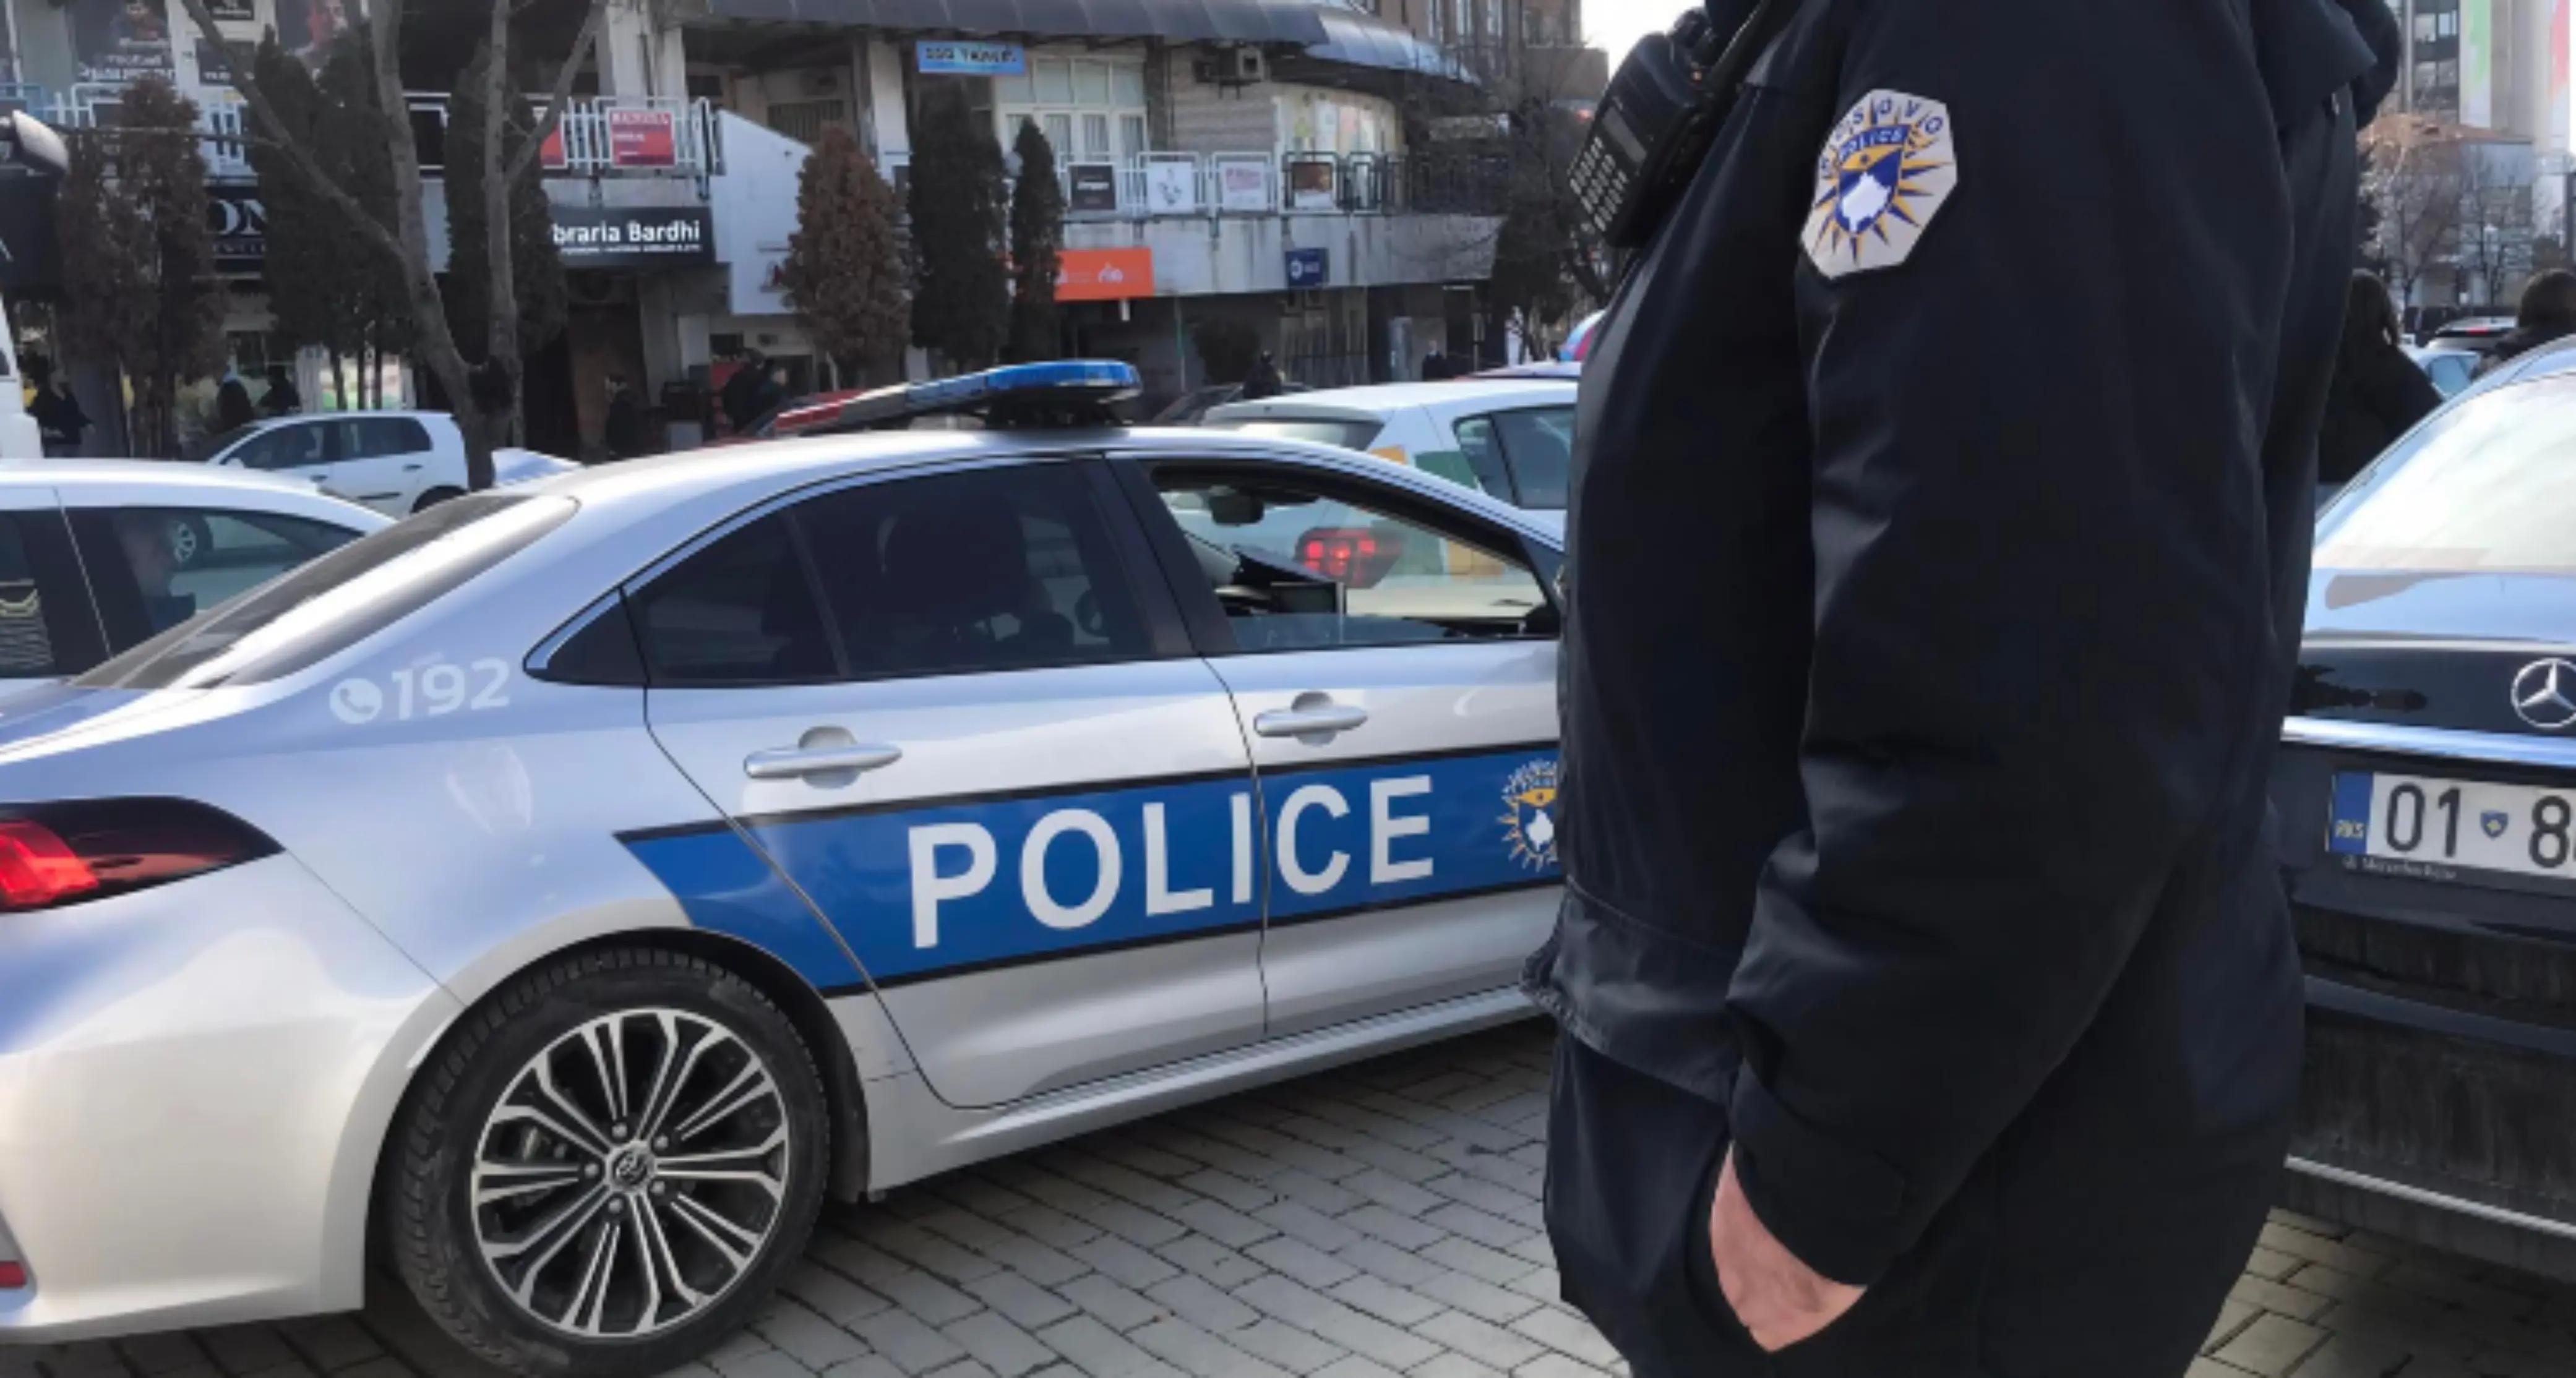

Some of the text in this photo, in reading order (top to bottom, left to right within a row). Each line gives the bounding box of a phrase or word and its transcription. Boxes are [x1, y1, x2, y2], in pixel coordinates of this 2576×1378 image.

[627, 220, 700, 242] Bardhi
[391, 656, 510, 721] 192
[908, 774, 1433, 949] POLICE
[2386, 782, 2576, 869] 01 8
